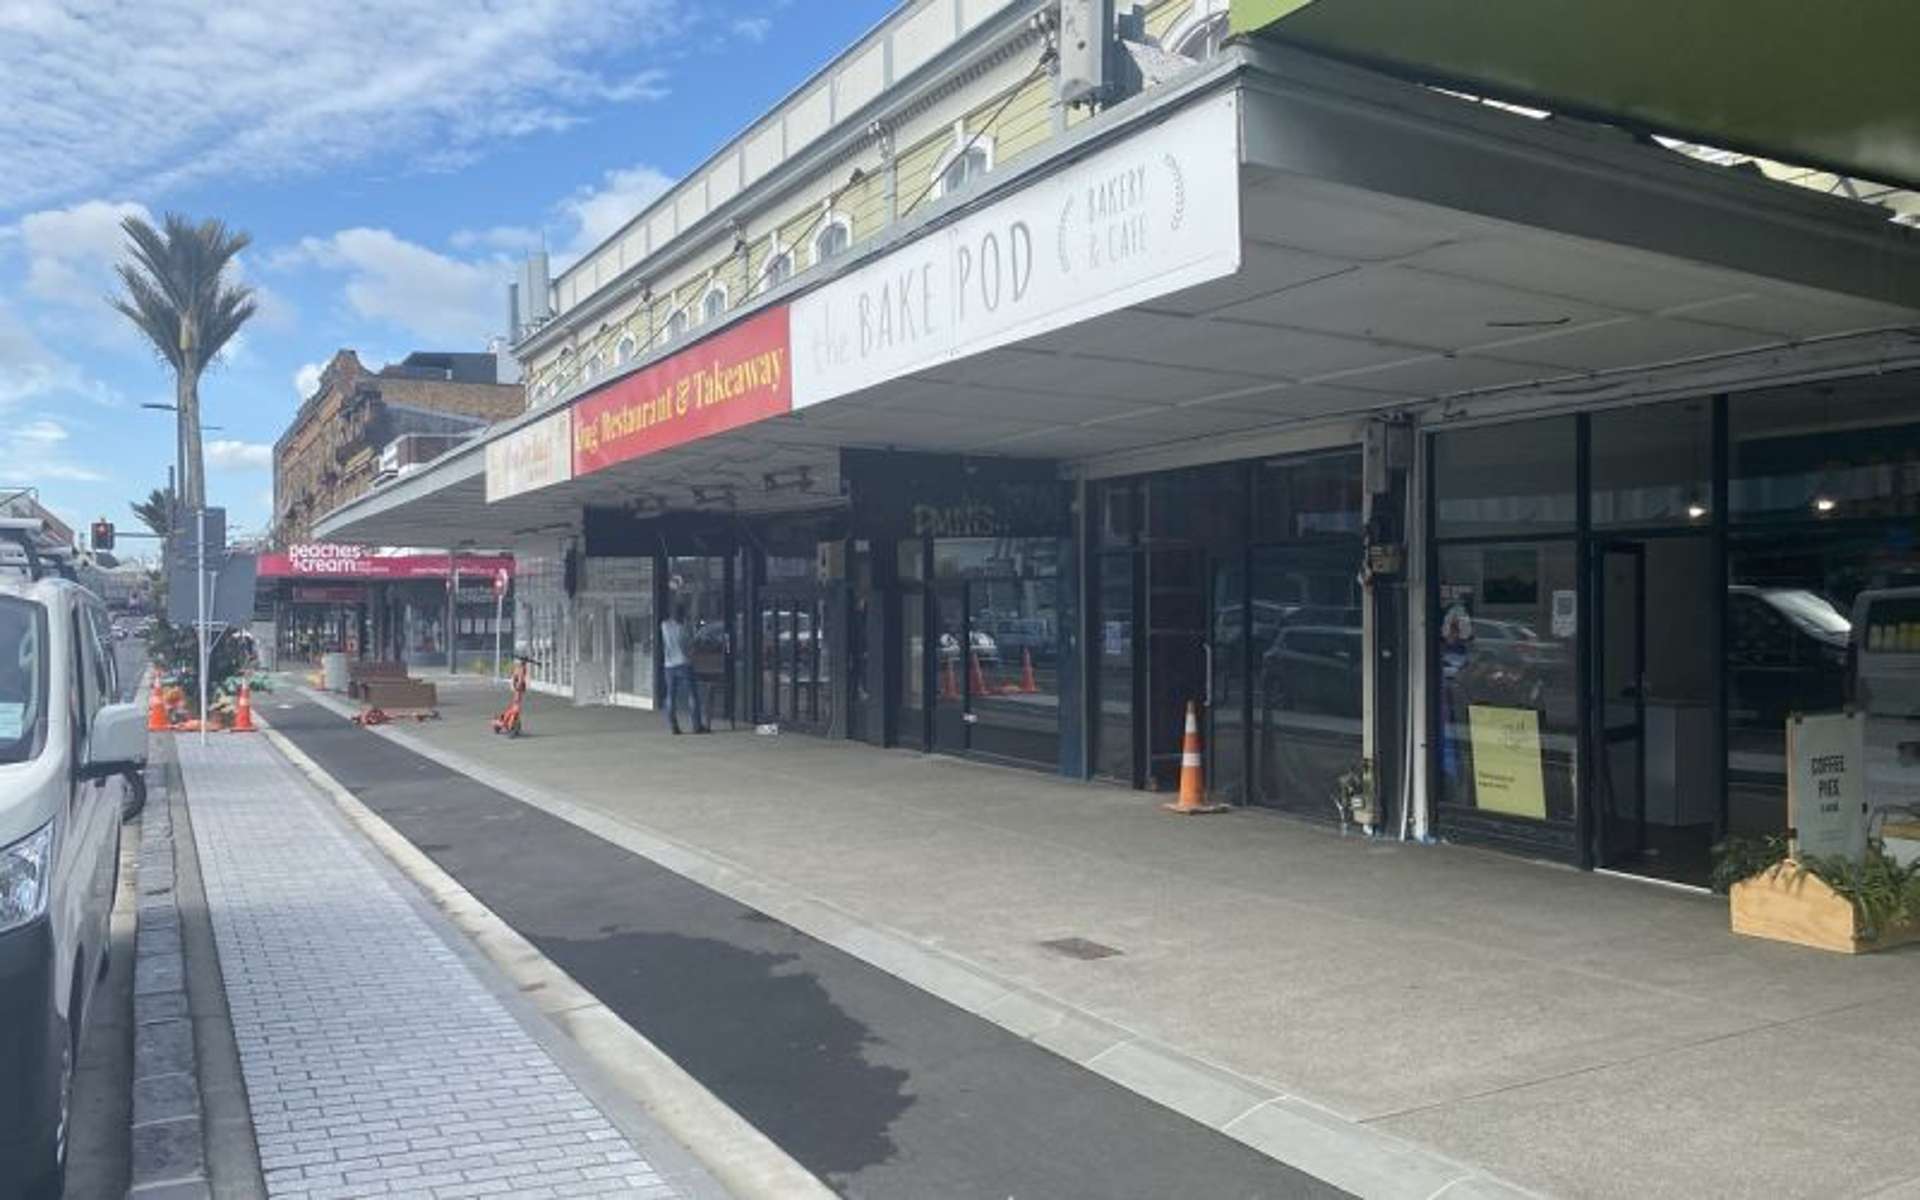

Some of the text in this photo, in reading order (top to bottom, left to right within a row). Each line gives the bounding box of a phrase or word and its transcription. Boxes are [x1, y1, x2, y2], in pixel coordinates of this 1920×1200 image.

[1088, 163, 1146, 223] BAKERY
[857, 261, 936, 359] BAKE
[958, 220, 1032, 326] POD
[600, 386, 674, 442] Restaurant
[676, 373, 690, 416] &
[693, 347, 785, 410] Takeaway
[288, 543, 362, 564] peaches
[299, 556, 356, 573] cream
